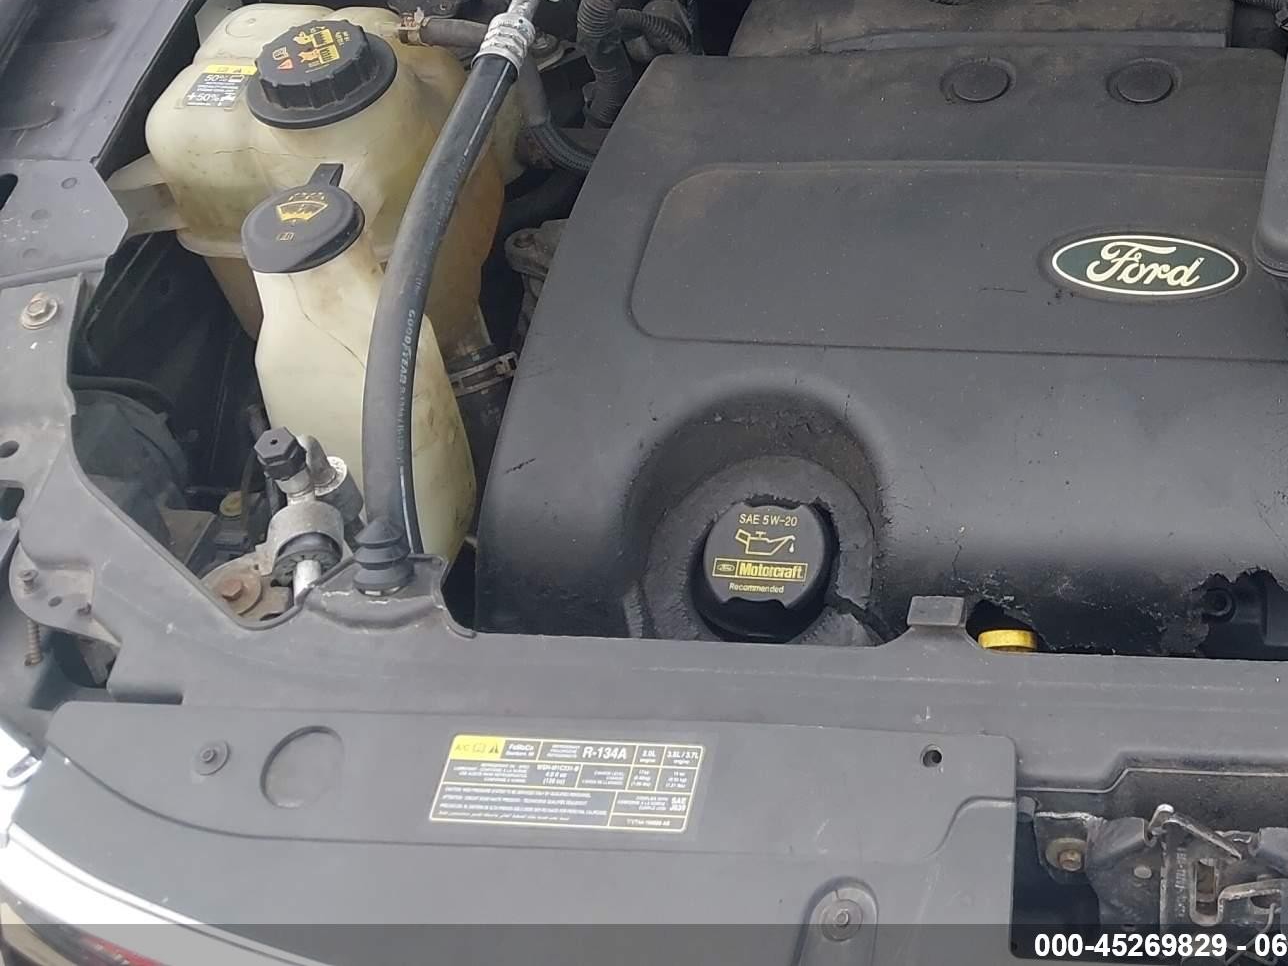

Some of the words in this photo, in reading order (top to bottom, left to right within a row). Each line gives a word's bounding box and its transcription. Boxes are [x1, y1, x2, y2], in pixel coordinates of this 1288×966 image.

[1086, 241, 1205, 287] Ford
[739, 514, 760, 525] SAE
[762, 515, 798, 527] 5W-20
[739, 562, 803, 578] Motorcraft
[729, 582, 784, 594] Recommended
[582, 746, 627, 760] R-134A
